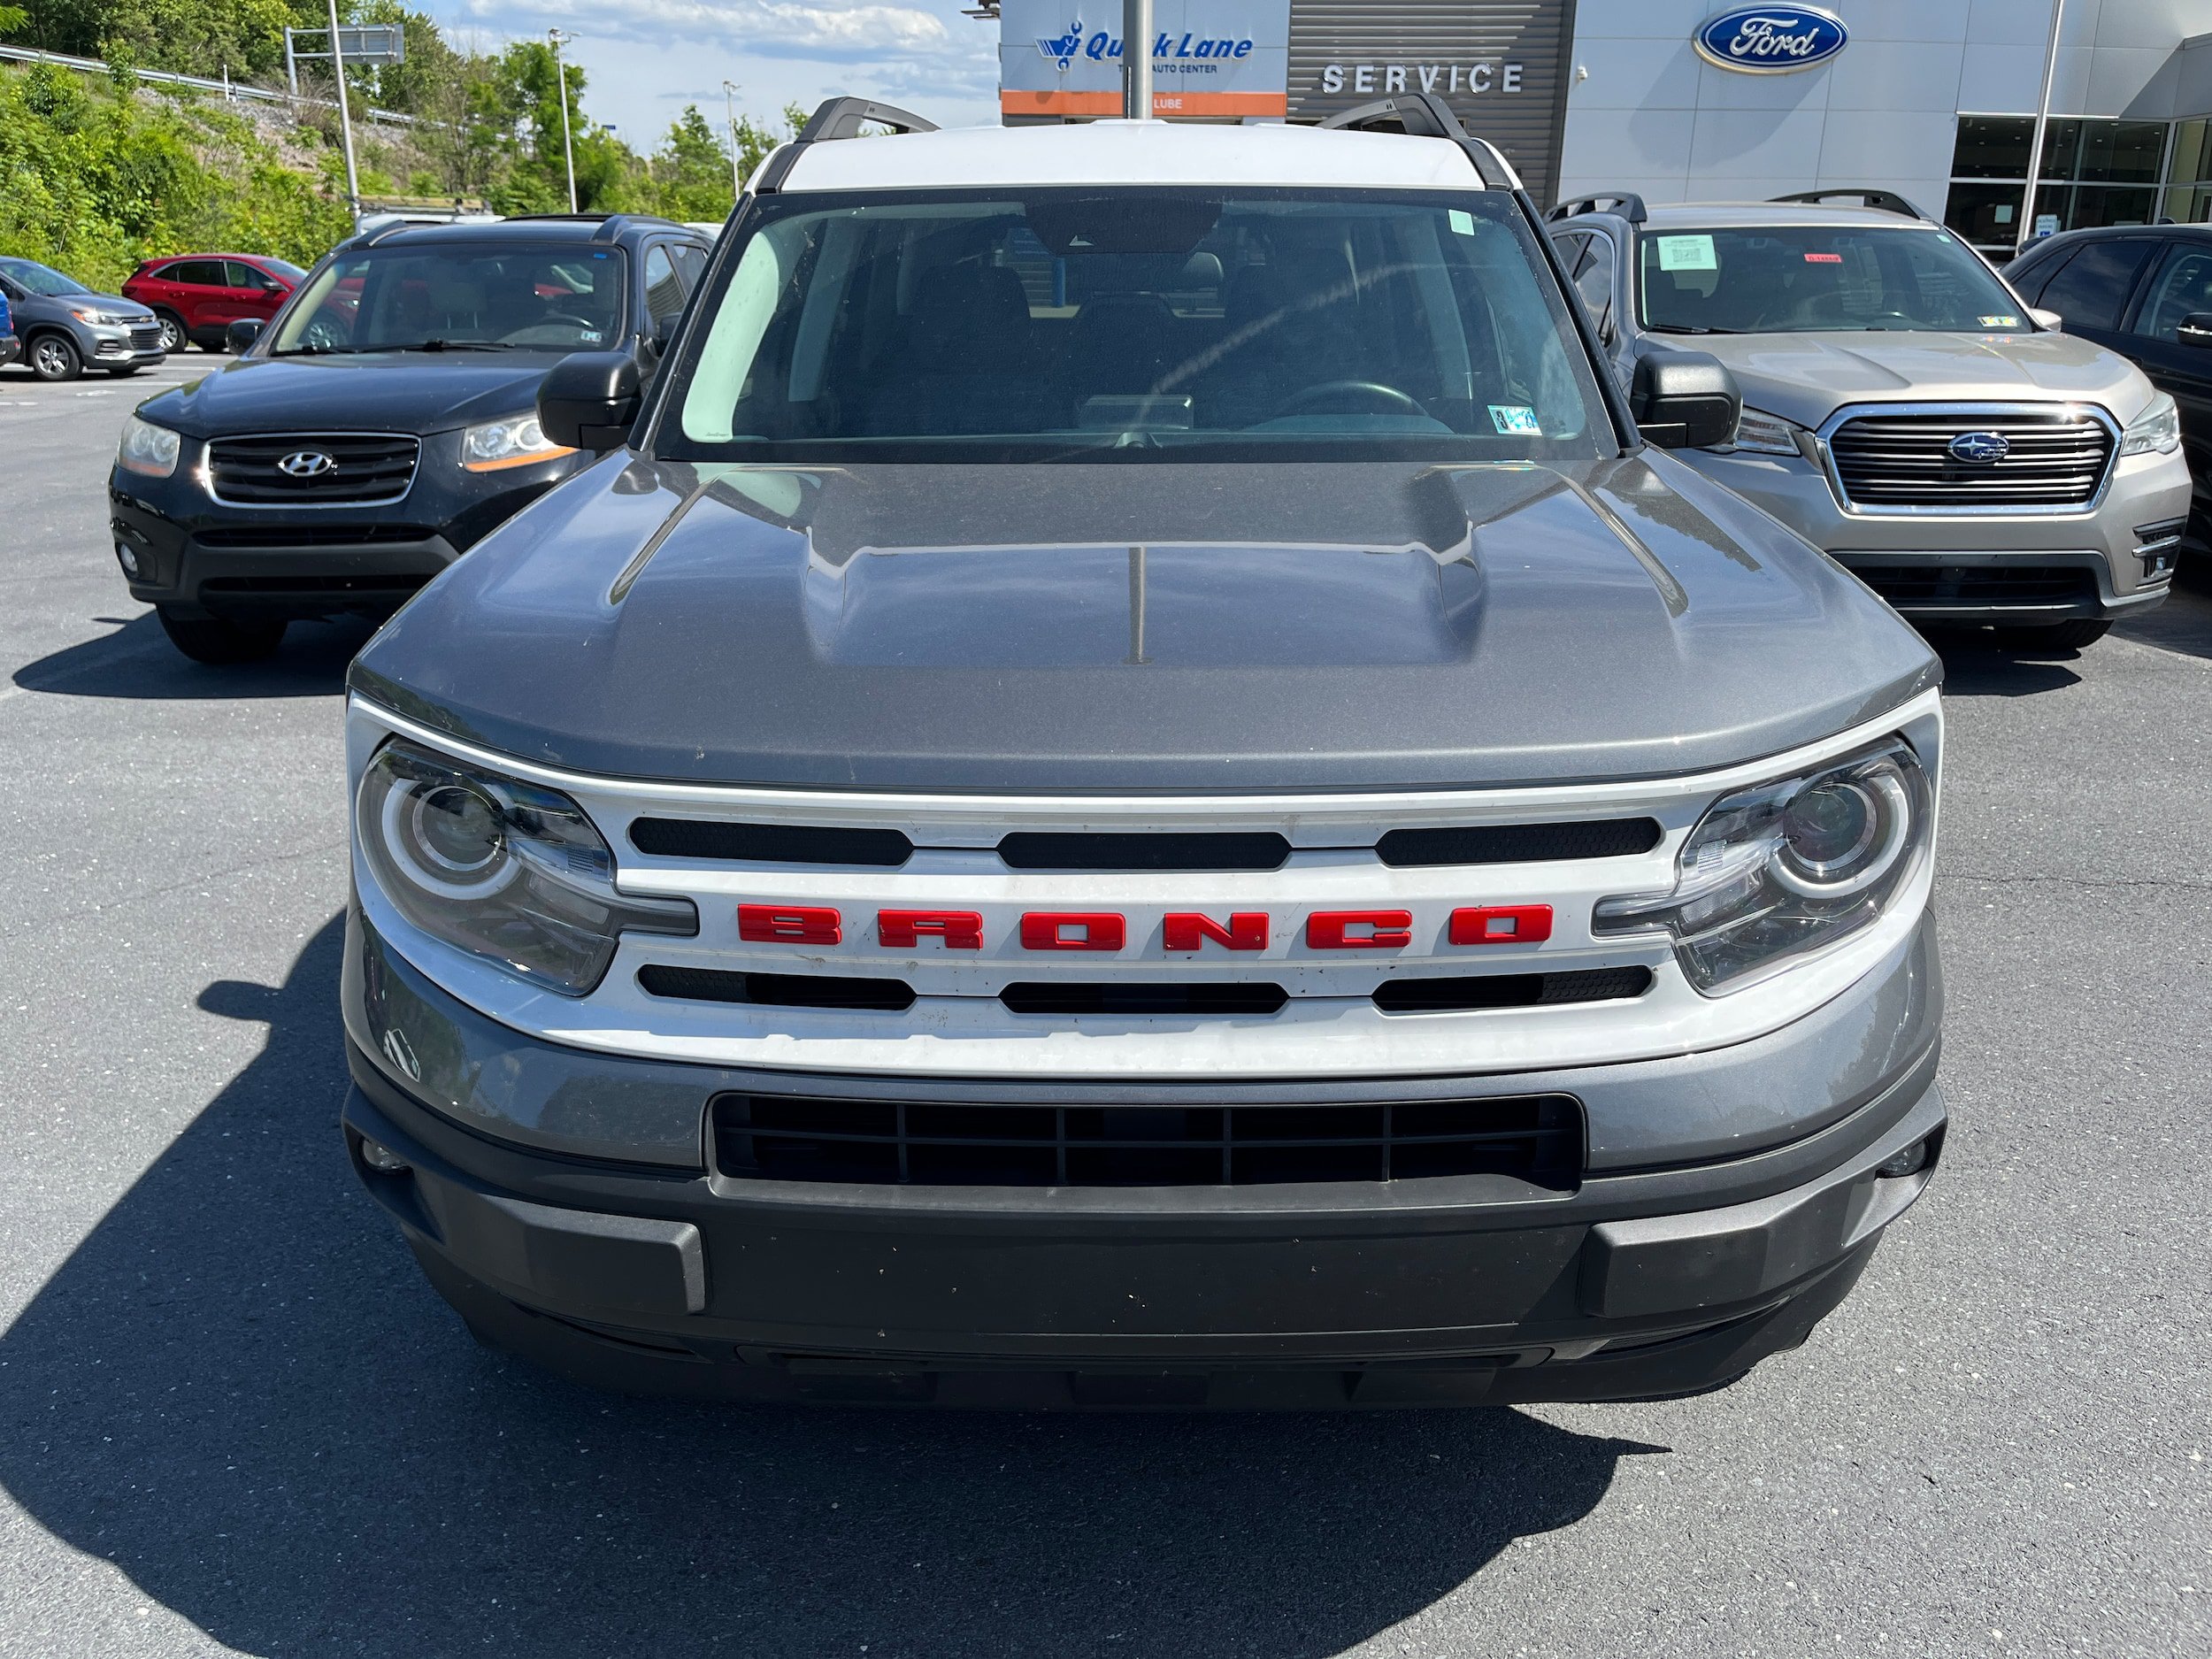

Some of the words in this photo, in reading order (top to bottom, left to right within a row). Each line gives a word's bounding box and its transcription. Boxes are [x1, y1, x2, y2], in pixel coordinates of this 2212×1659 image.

[1085, 32, 1172, 60] Quk
[1175, 33, 1253, 58] Lane
[1729, 17, 1820, 57] Ford
[1179, 65, 1217, 73] CENTER
[1322, 63, 1524, 94] SERVICE
[1153, 98, 1183, 109] LUBE
[737, 904, 1554, 951] BRONCO
